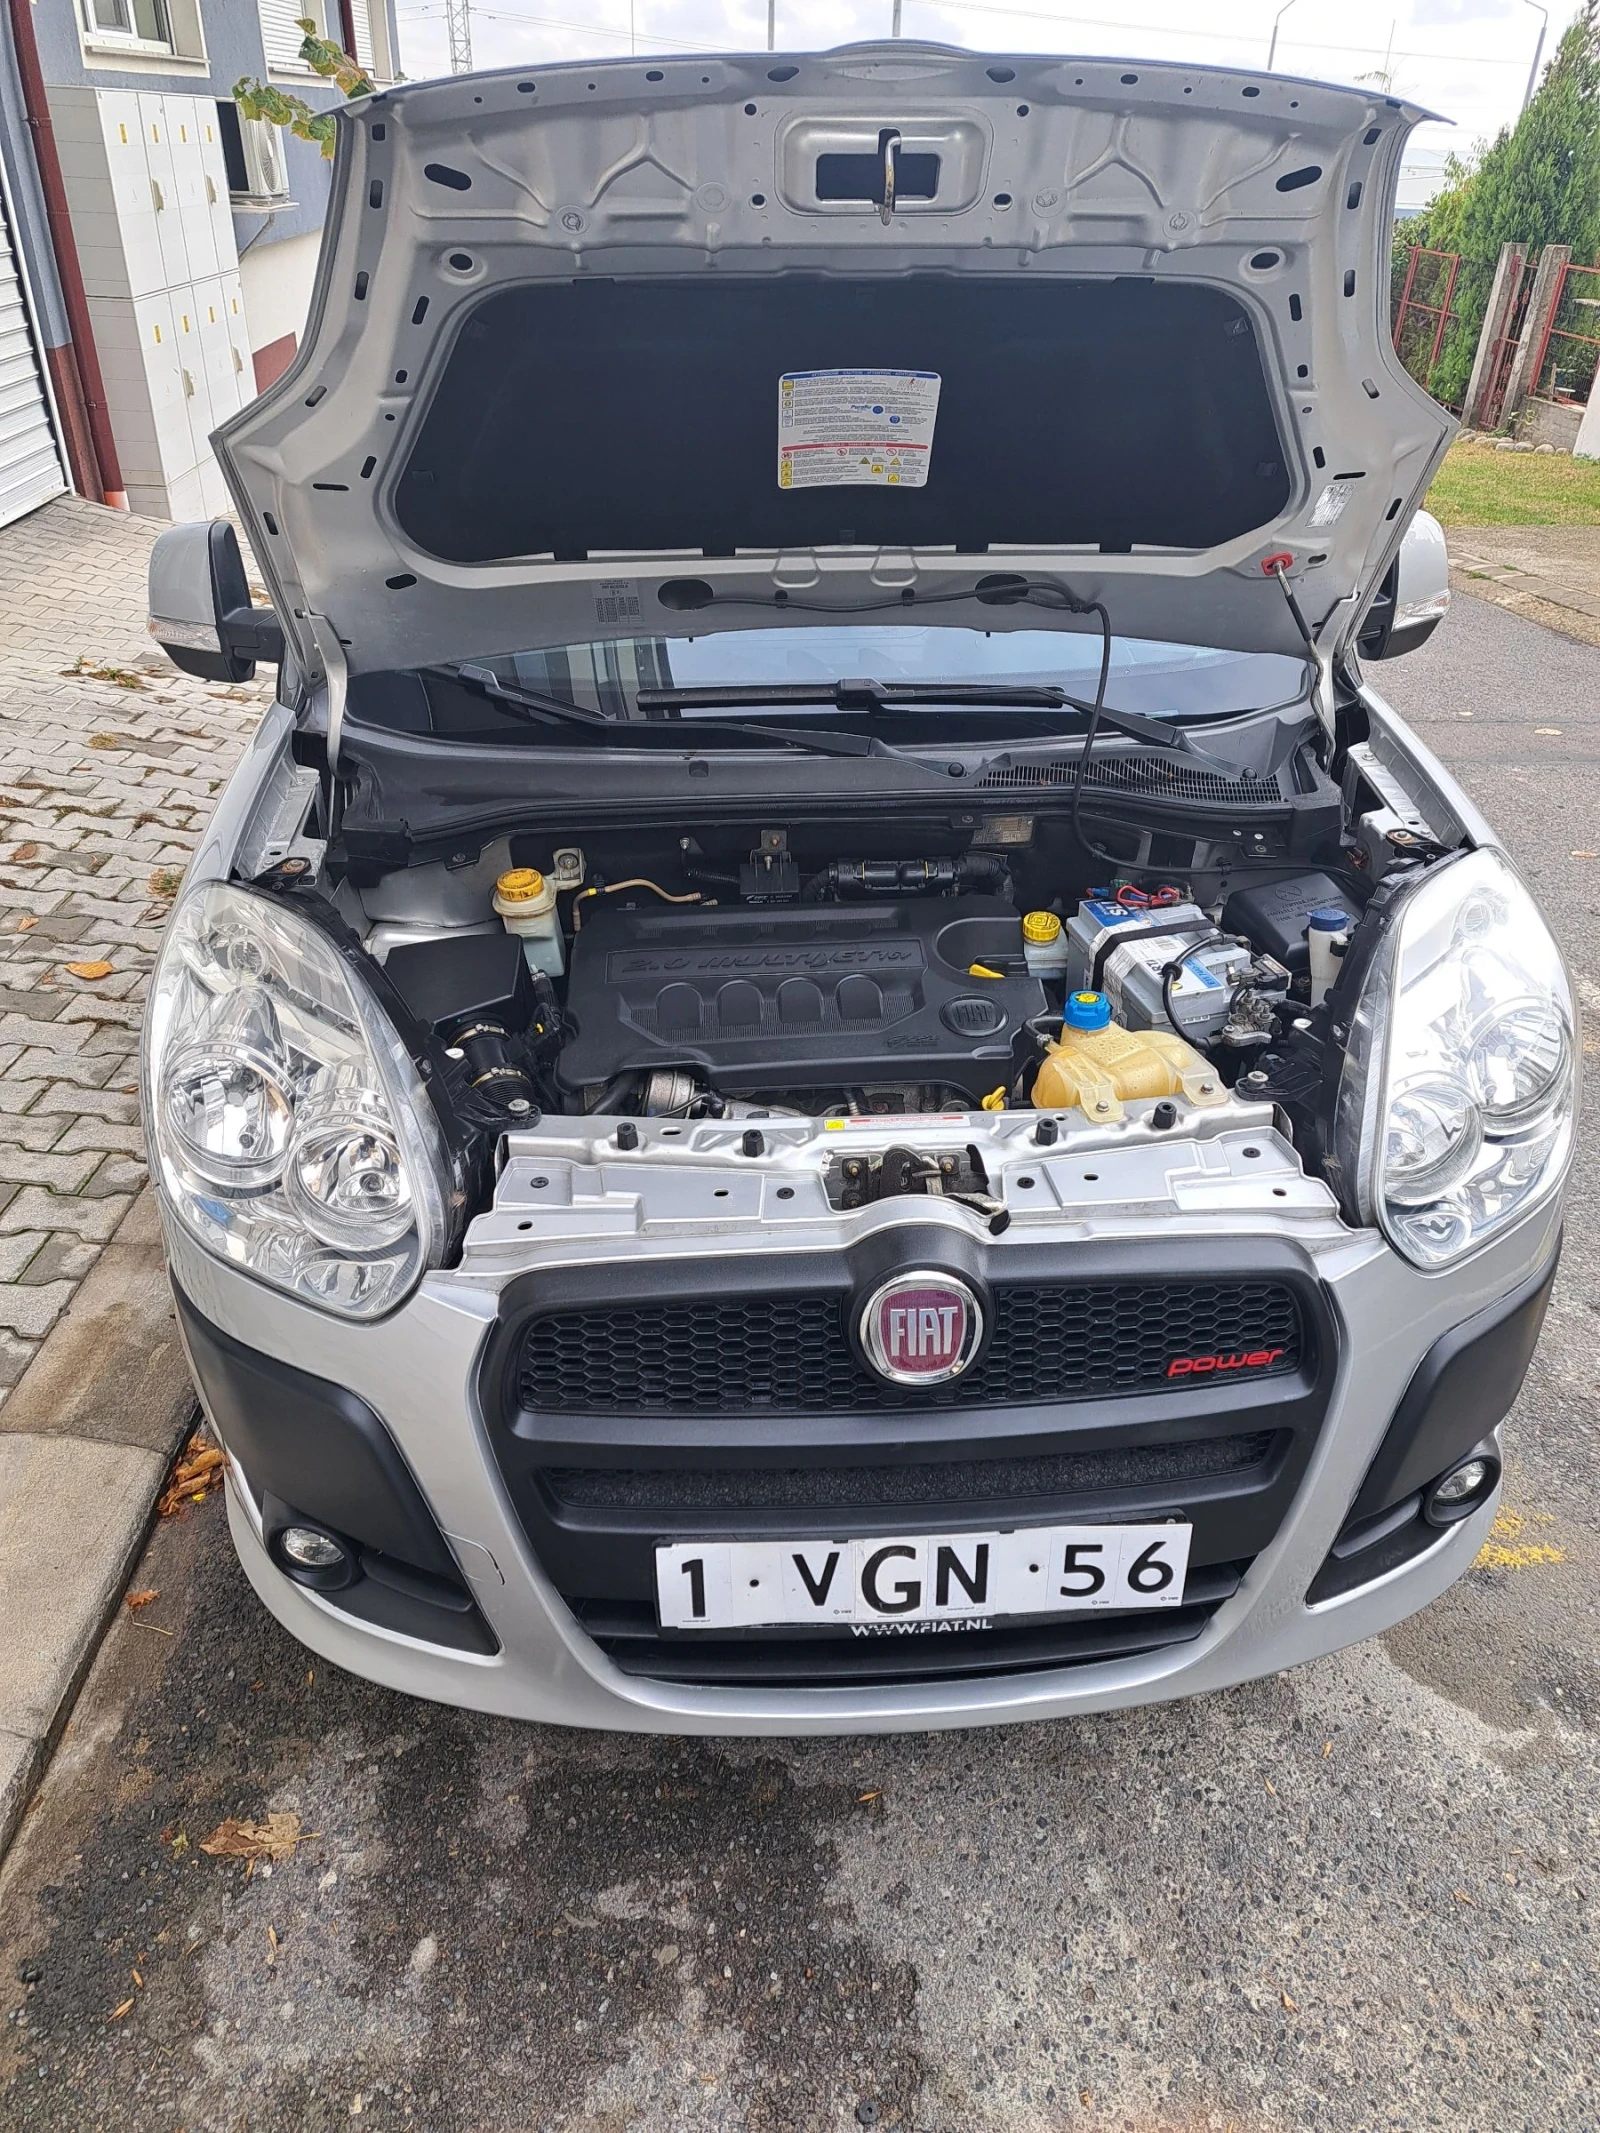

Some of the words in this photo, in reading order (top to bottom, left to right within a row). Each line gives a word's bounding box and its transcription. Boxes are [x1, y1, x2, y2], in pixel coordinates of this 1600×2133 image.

[621, 956, 690, 973] 2.0
[955, 1003, 994, 1024] FIAT
[889, 1306, 959, 1356] FIAT
[1167, 1349, 1285, 1378] power
[680, 1557, 707, 1618] 1
[791, 1543, 991, 1616] VGN
[1059, 1540, 1175, 1598] 56
[850, 1618, 993, 1637] WWW.FIAT.NL
